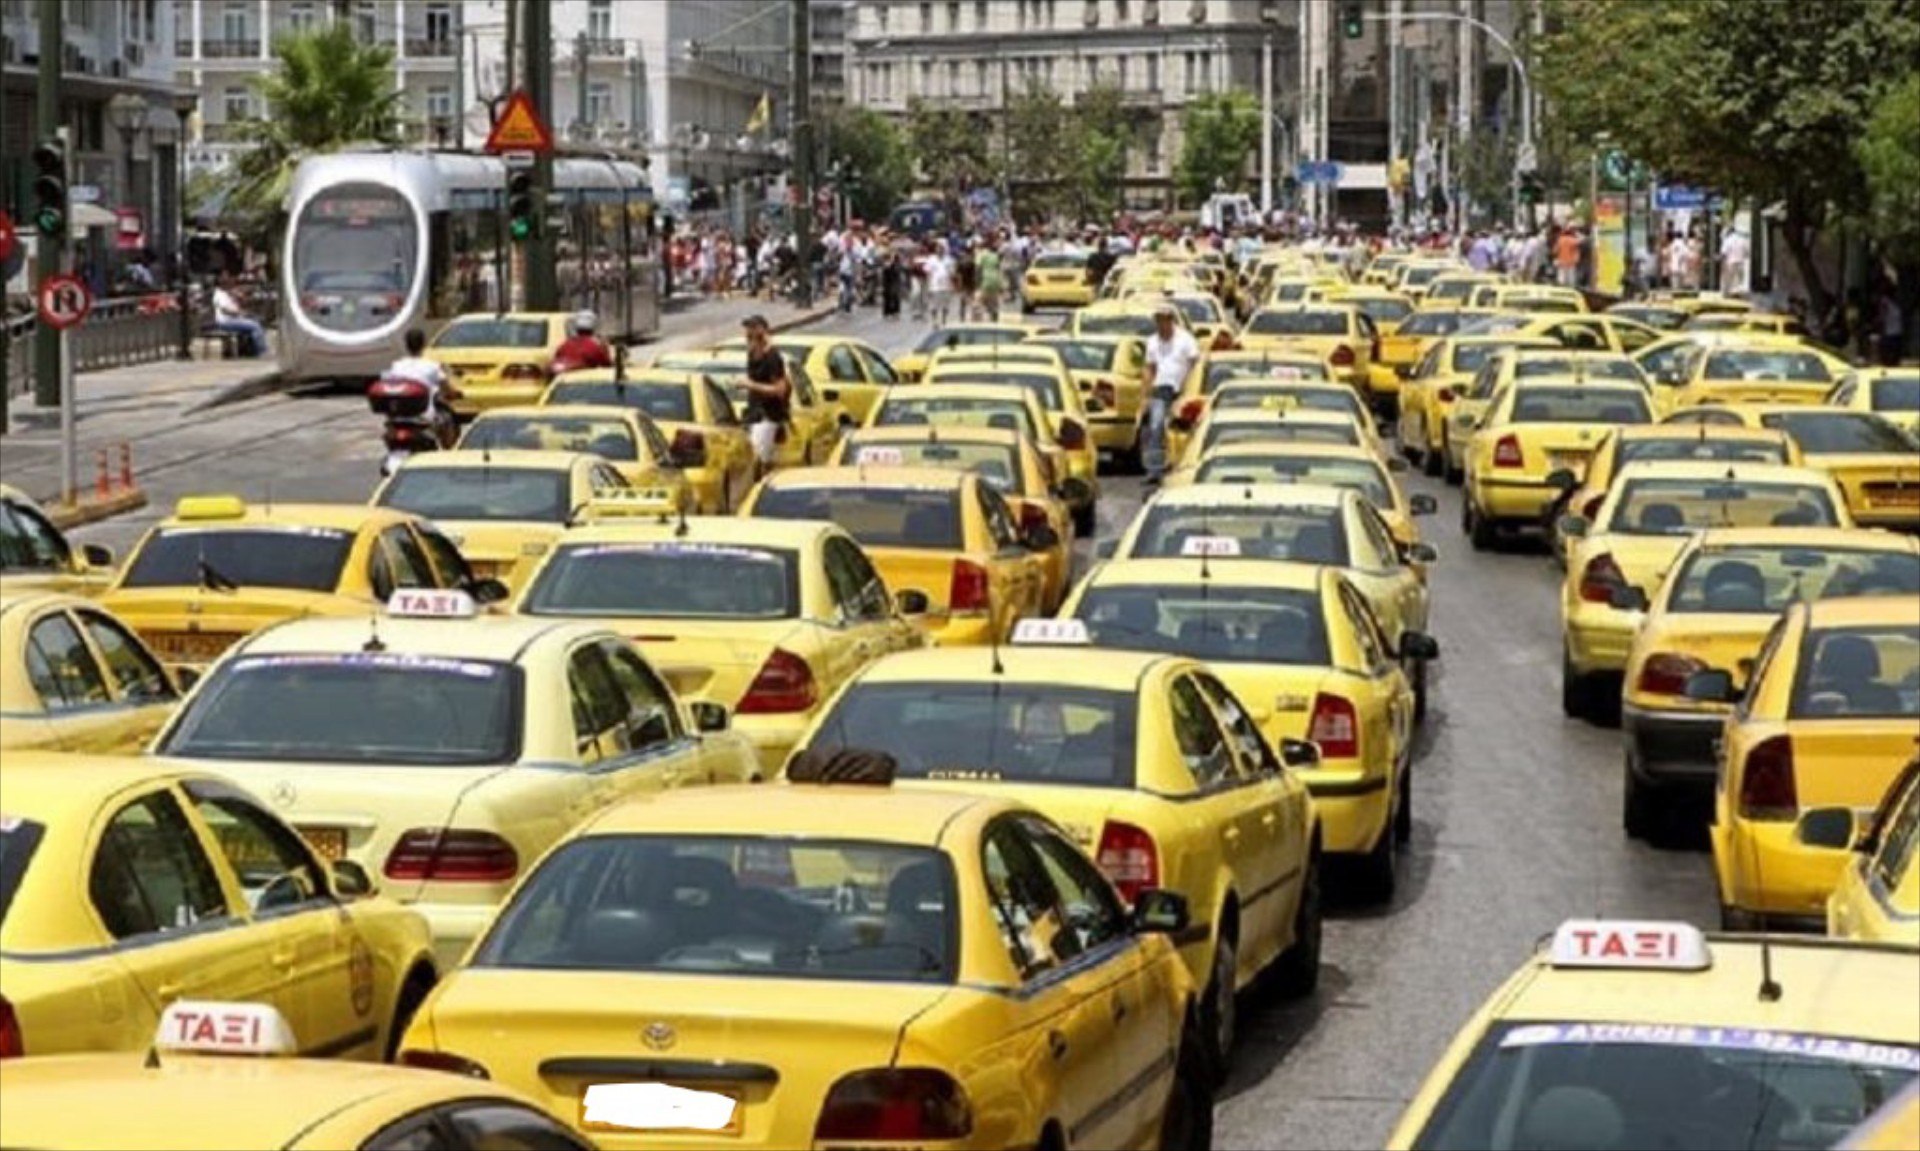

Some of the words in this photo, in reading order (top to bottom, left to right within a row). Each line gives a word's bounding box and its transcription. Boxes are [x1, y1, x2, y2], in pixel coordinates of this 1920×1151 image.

[1572, 930, 1677, 957] ΤΑΞΙ
[174, 1012, 261, 1044] ΤΑΞΙ
[1563, 1023, 1694, 1045] ATHENS
